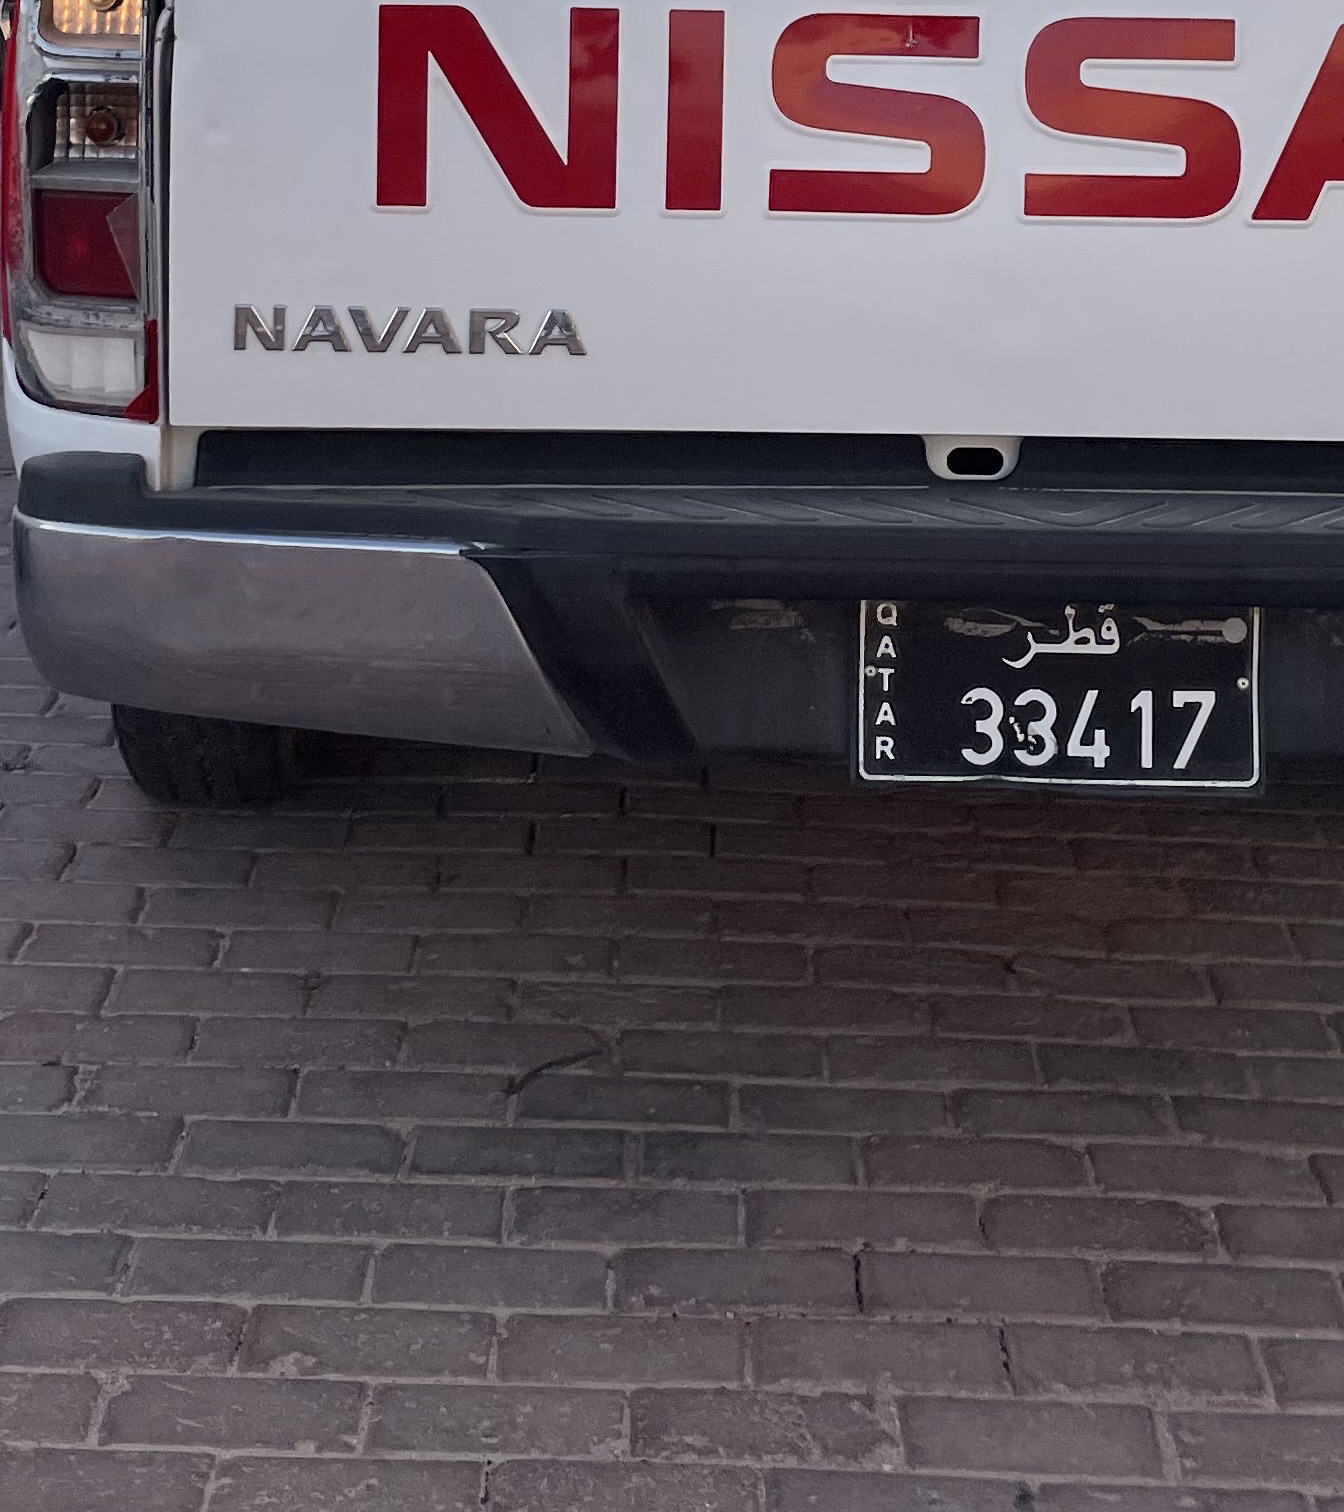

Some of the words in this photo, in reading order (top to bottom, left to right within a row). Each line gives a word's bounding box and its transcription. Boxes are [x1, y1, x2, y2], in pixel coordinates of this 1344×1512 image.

[232, 303, 588, 356] NAVARA
[1001, 602, 1121, 669] قطر
[874, 601, 897, 761] QATAR
[960, 687, 1217, 770] 33417
